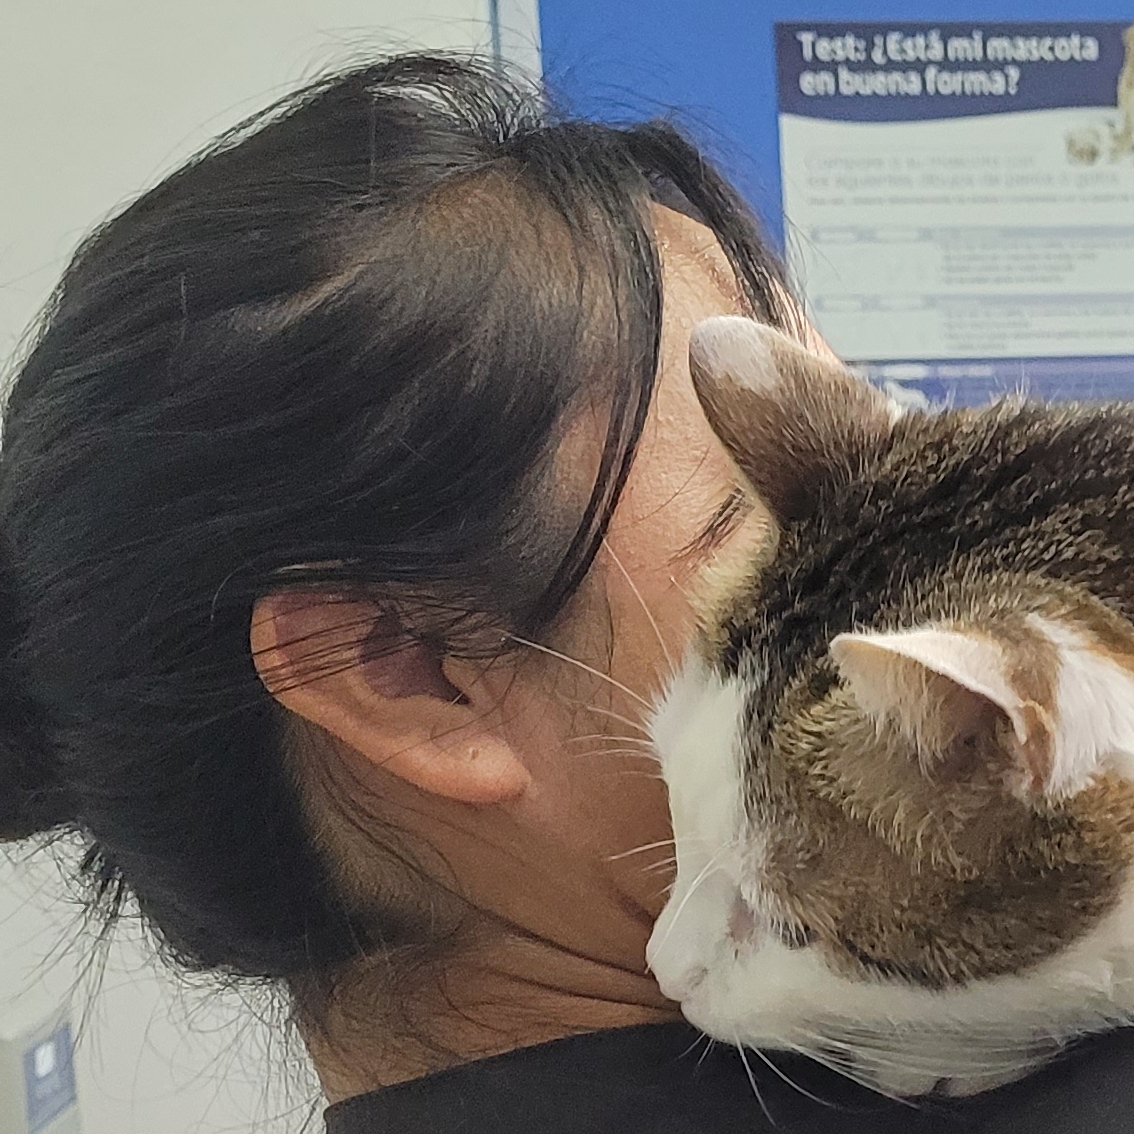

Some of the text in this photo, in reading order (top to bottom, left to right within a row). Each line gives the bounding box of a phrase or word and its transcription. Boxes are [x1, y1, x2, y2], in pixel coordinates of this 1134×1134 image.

[797, 29, 1099, 65] Test: ¿Está mi mascota
[799, 64, 1020, 96] en buena forma?
